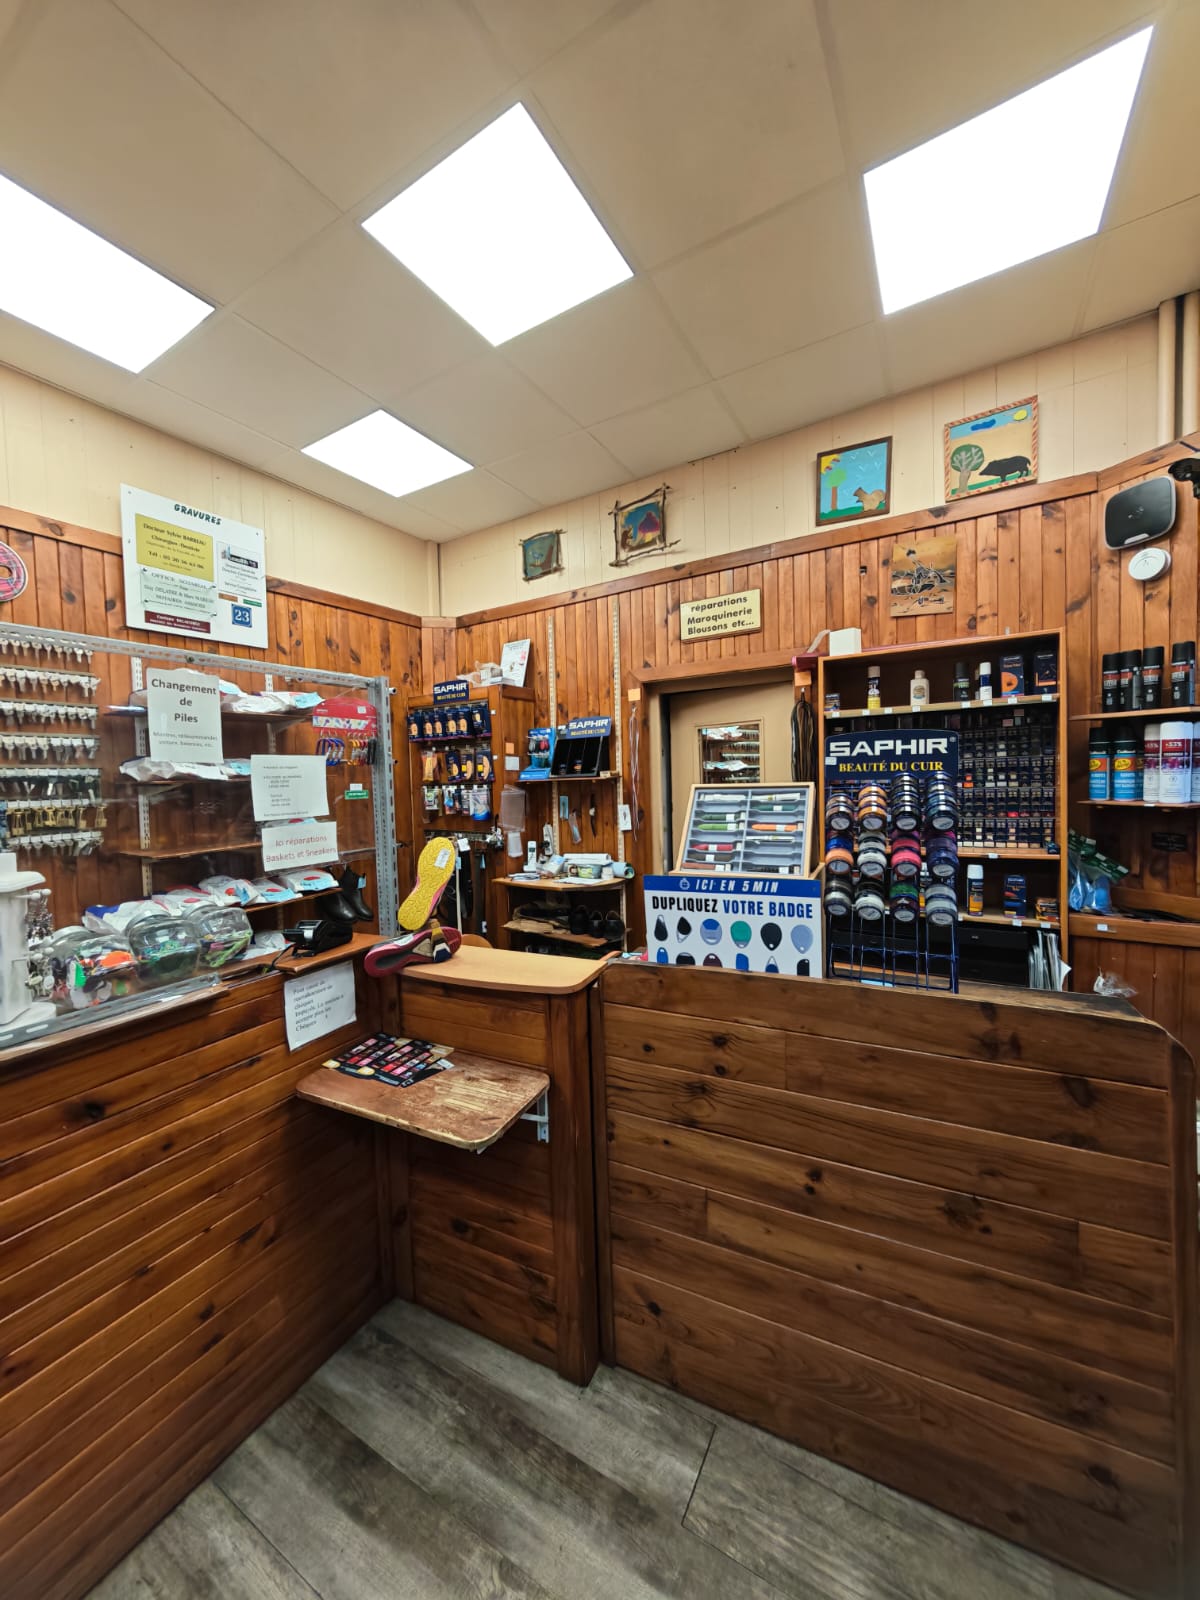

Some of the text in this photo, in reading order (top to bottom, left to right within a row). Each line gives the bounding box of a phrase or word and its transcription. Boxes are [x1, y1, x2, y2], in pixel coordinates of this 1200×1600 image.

[174, 504, 221, 525] GRAVURES
[691, 597, 748, 612] réparations
[235, 609, 250, 623] 23
[687, 607, 752, 625] Maroquinerie
[688, 622, 728, 635] Blousons
[151, 678, 216, 695] Changement
[434, 683, 467, 694] SAPHIR
[179, 697, 193, 706] de
[174, 713, 199, 723] Piles
[568, 718, 609, 729] SAPHIR
[829, 738, 948, 757] SAPHIR
[839, 760, 944, 773] BEAUTÉ DU CUIR
[286, 835, 327, 847] réparations
[266, 852, 296, 862] Baskets
[305, 847, 336, 858] Sneakers
[696, 879, 714, 890] ICI
[720, 880, 735, 891] EN
[652, 896, 813, 918] DUPLIQUEZ VOTRE BADGE
